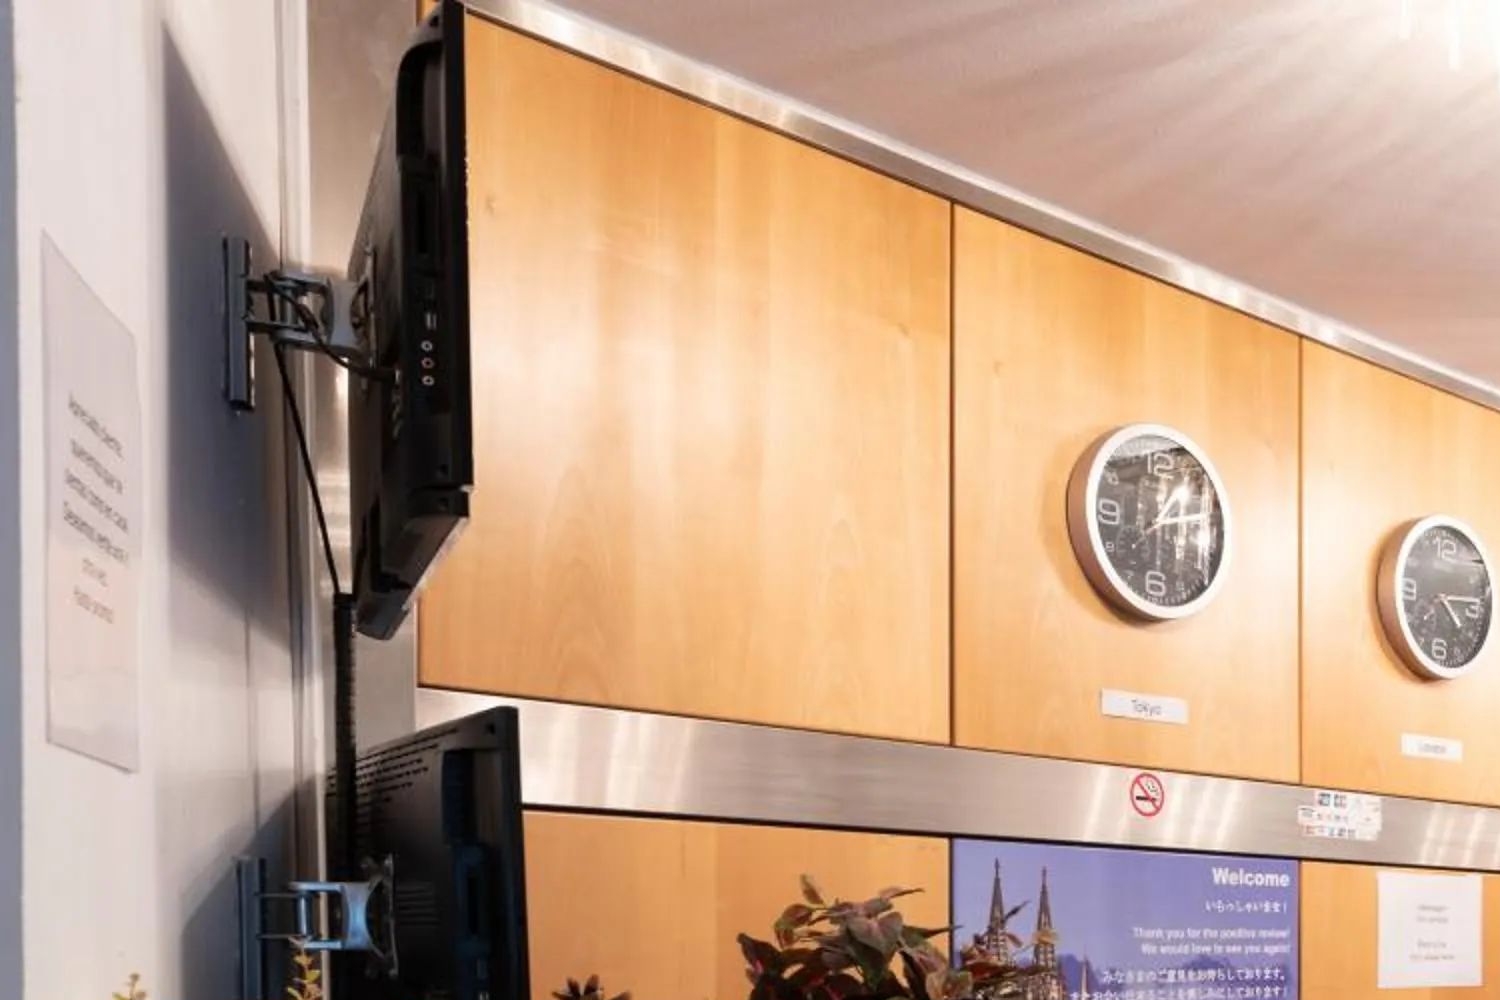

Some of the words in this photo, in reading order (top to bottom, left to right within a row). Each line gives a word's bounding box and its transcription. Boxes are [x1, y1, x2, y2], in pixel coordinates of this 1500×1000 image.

[1147, 453, 1176, 479] 12
[1098, 498, 1120, 525] 9
[1436, 537, 1457, 561] 12
[1145, 570, 1167, 597] 6
[1431, 638, 1447, 660] 6
[1131, 699, 1162, 717] Tokyo
[1211, 867, 1291, 887] Welcome
[1132, 927, 1164, 939] Thank
[1166, 929, 1185, 941] you
[1187, 927, 1201, 939] for
[1159, 943, 1190, 955] would
[1191, 943, 1213, 954] love
